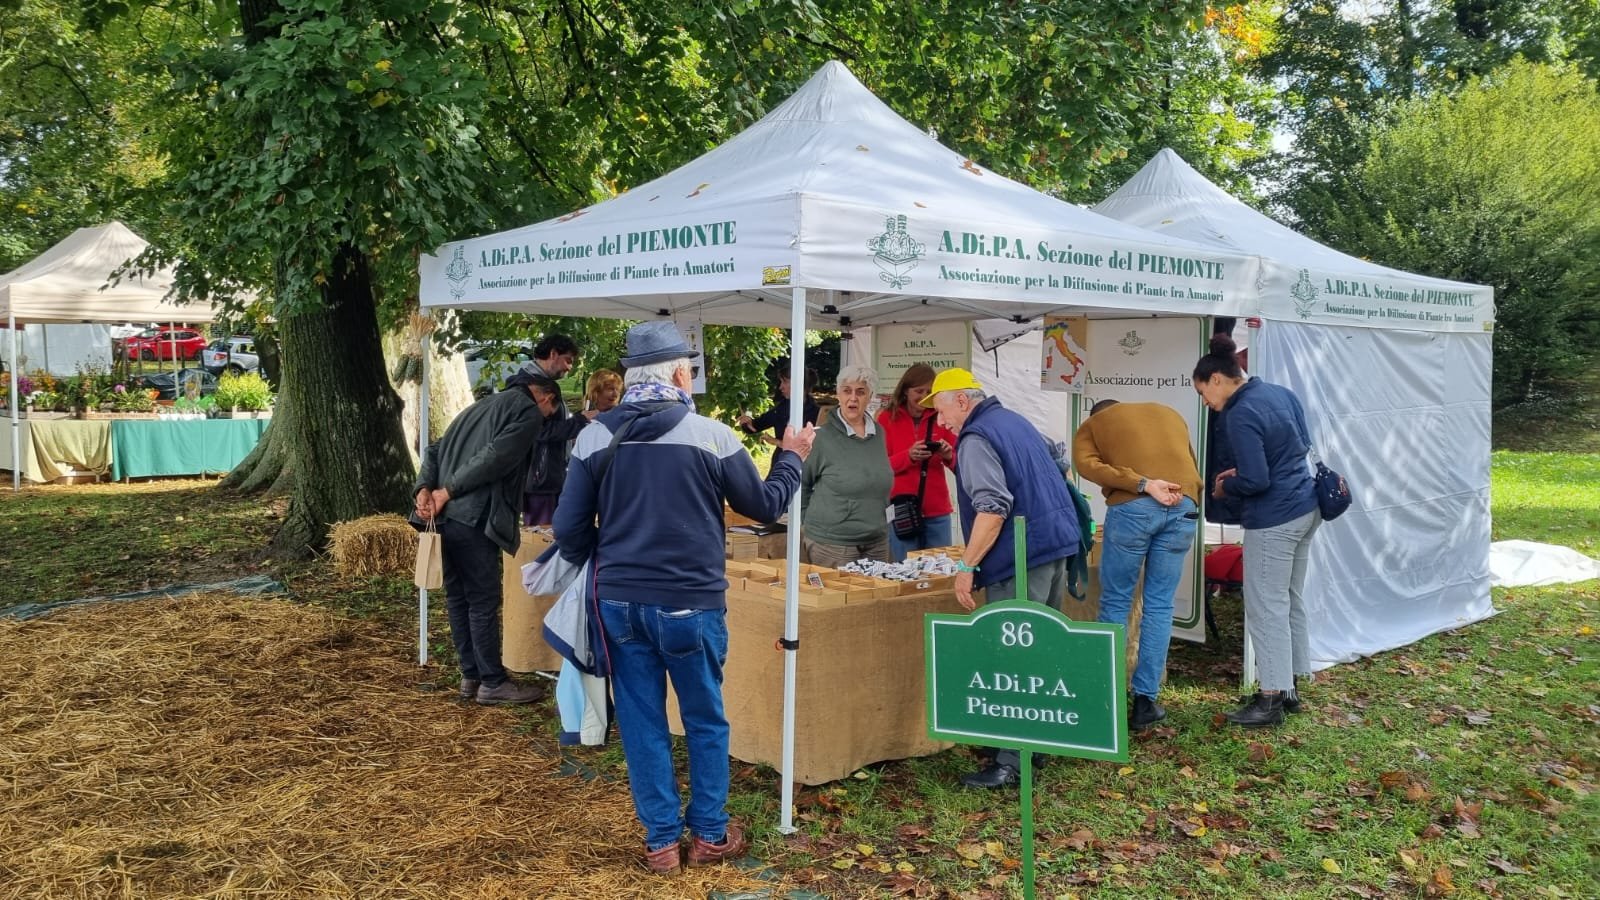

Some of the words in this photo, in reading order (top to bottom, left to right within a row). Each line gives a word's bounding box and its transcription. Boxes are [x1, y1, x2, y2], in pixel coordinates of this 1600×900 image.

[479, 245, 535, 267] A.Di.P.A.
[540, 240, 592, 262] Sezione
[597, 235, 622, 256] del
[627, 220, 736, 254] PIEMONTE
[938, 230, 1031, 260] A.Di.P.A.
[1037, 240, 1103, 268] Sezione
[1108, 249, 1132, 271] del
[1138, 253, 1225, 280] PIEMONTE
[478, 275, 527, 289] Associazione
[530, 277, 545, 289] per
[547, 272, 556, 284] la
[558, 269, 607, 284] Diffusione
[610, 267, 620, 280] di
[624, 265, 659, 279] Piante
[662, 262, 679, 277] fra
[683, 257, 735, 276] Amatori
[938, 265, 1021, 285] Associazione
[1025, 276, 1045, 290] per
[1048, 274, 1059, 288] la
[1063, 275, 1119, 293] Diffusione
[1122, 281, 1132, 294] di
[1136, 282, 1168, 297] Piante
[1171, 286, 1184, 299] fra
[1187, 287, 1224, 302] Amatori
[1324, 278, 1372, 298] A.Di.P.A.
[1374, 284, 1409, 302] Sezione
[1411, 288, 1424, 303] del
[1367, 309, 1378, 319] per
[1380, 307, 1386, 318] la
[1084, 370, 1154, 386] Associazione
[1157, 376, 1178, 389] per
[1181, 373, 1192, 387] la
[1083, 396, 1099, 412] D
[1001, 621, 1034, 647] 86
[968, 671, 1077, 699] A.Di.P.A.
[966, 696, 1079, 725] Piemonte
